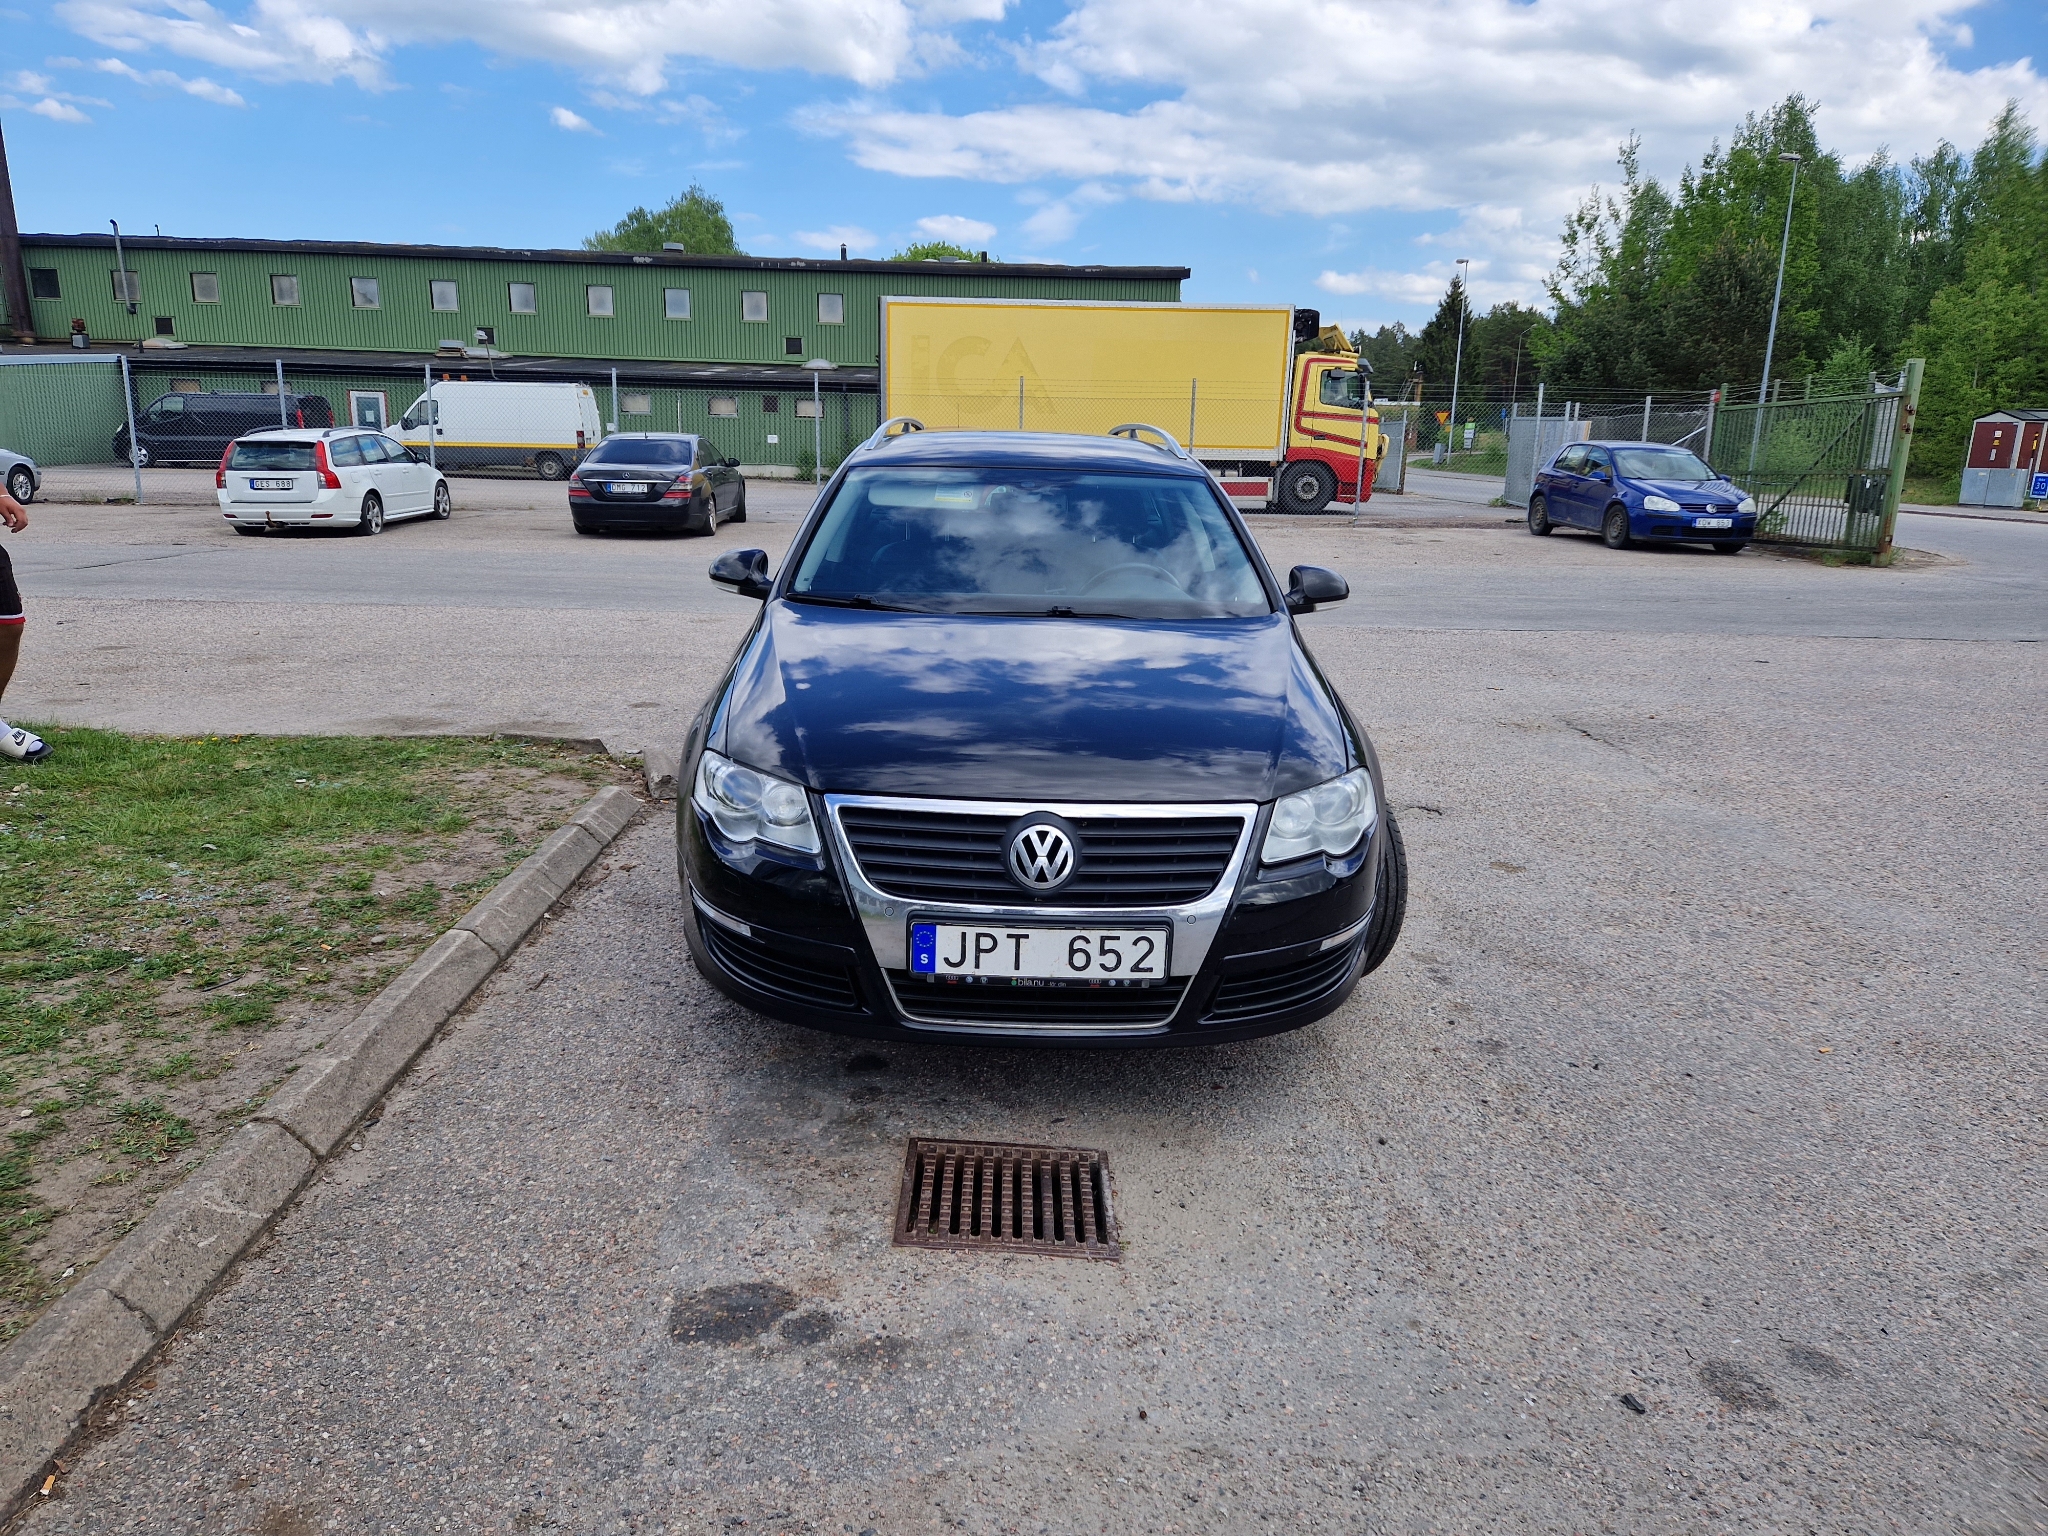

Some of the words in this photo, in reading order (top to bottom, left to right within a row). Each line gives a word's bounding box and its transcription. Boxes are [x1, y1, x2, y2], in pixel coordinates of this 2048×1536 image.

[255, 480, 270, 488] GES
[275, 480, 291, 488] 688
[631, 484, 646, 492] 712
[2034, 481, 2046, 490] 30
[943, 931, 1030, 970] JPT
[1067, 934, 1155, 973] 652
[920, 953, 929, 964] S
